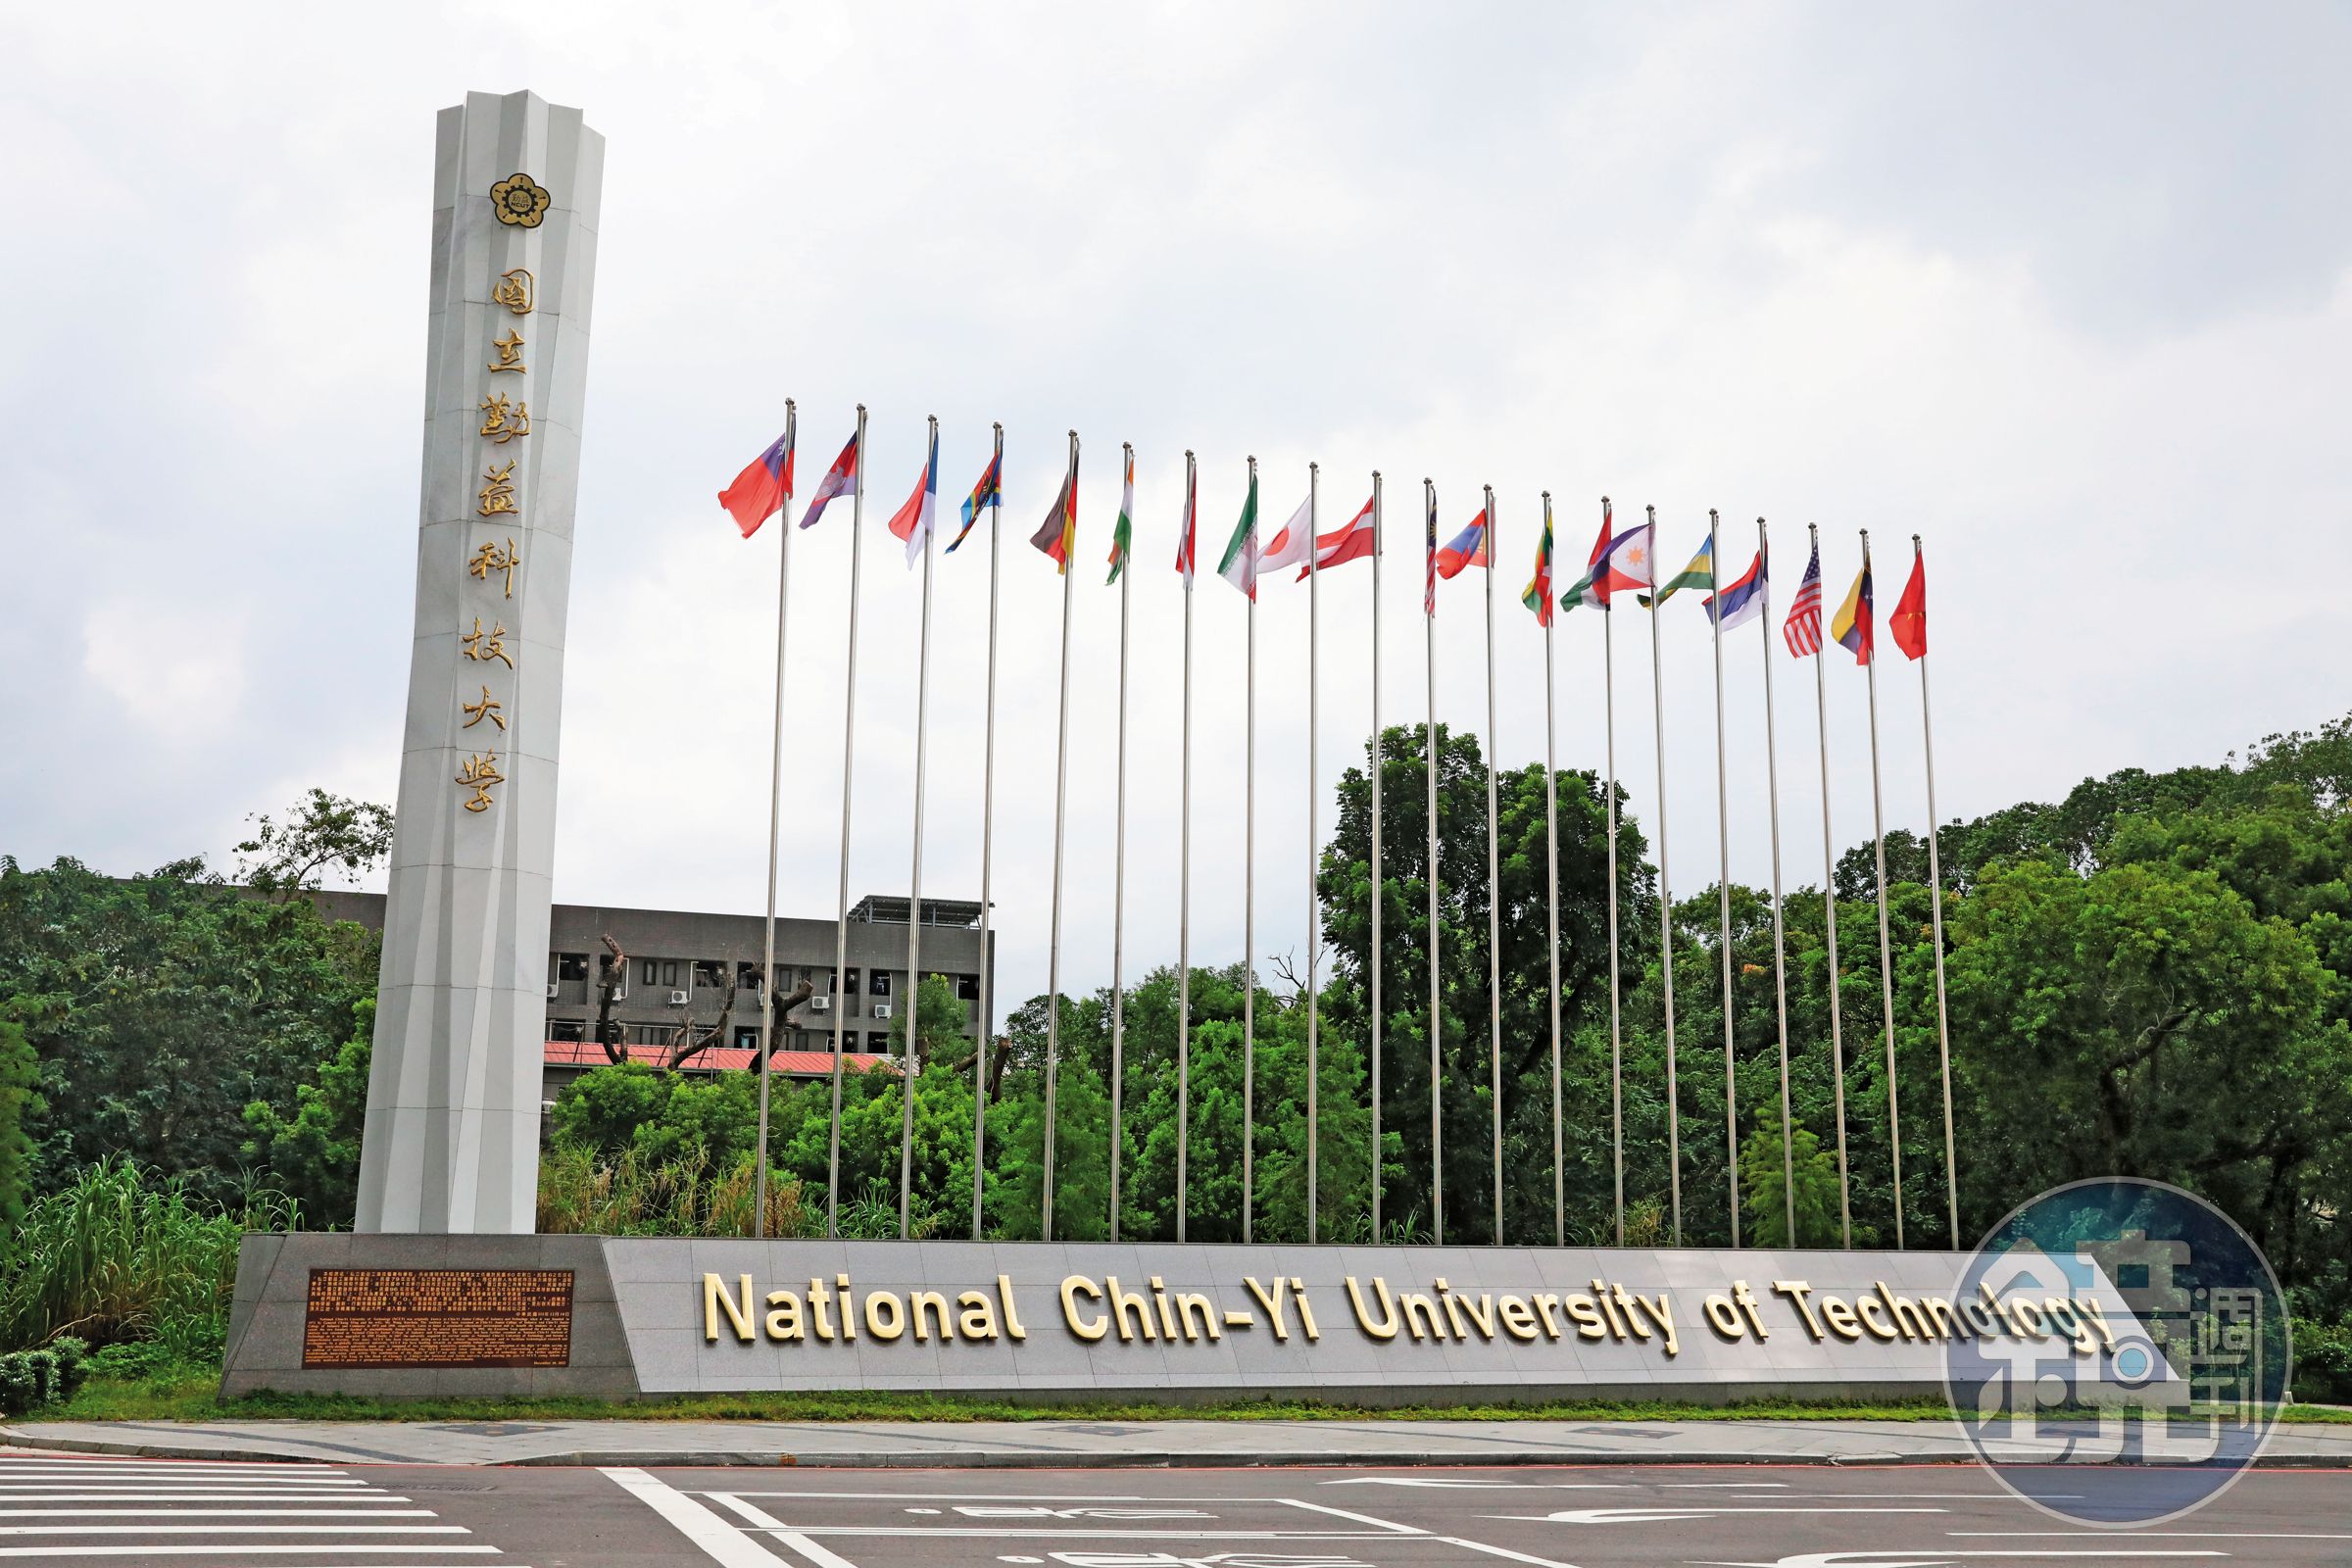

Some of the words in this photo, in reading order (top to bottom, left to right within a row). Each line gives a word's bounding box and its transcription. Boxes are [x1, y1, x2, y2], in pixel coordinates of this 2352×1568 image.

[454, 267, 535, 813] 國立勤益科技大學
[704, 1272, 1026, 1343] National
[1060, 1274, 1321, 1343] Chin-Yi
[1345, 1276, 1679, 1356] University
[1705, 1279, 1770, 1342] of
[1772, 1279, 2118, 1355] Technology
